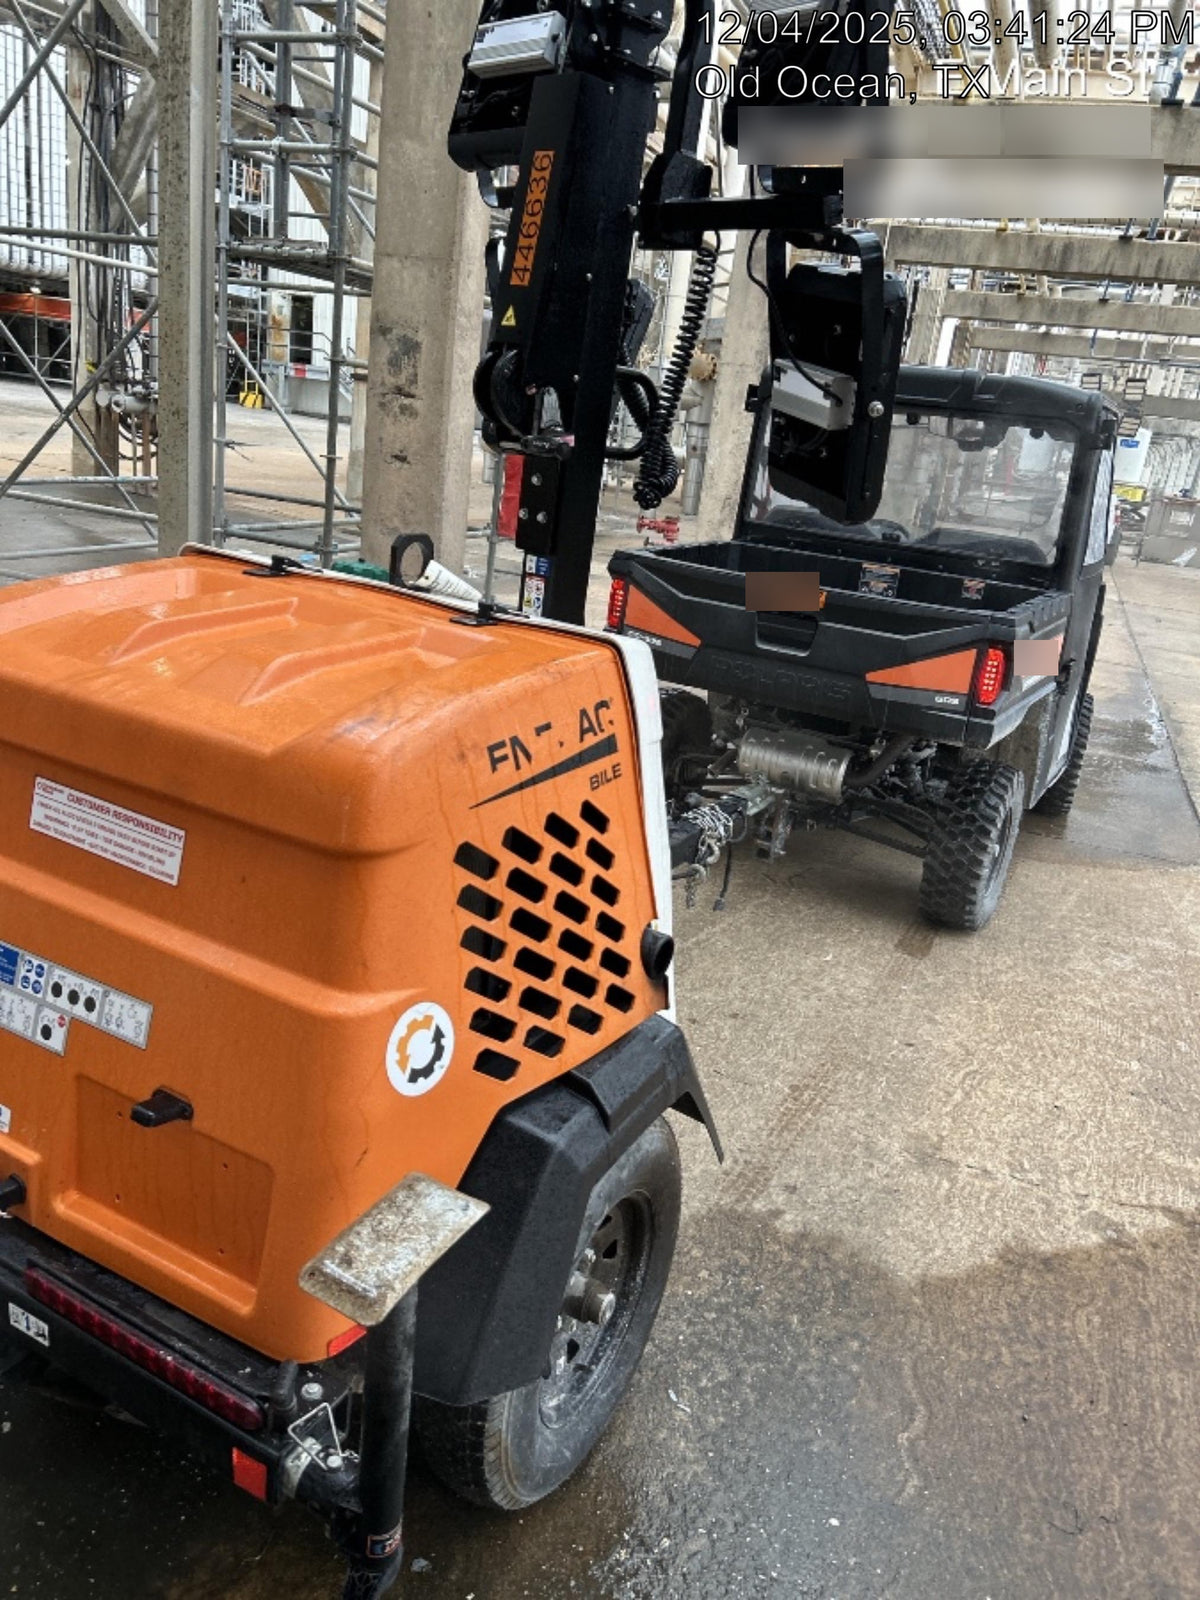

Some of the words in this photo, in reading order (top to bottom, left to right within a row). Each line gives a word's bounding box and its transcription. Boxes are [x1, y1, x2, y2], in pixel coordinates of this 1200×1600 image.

[512, 153, 552, 283] 446636
[589, 762, 623, 791] BILE
[67, 792, 111, 816] CUSTOMER
[111, 810, 184, 842] RESPONSIBILITY
